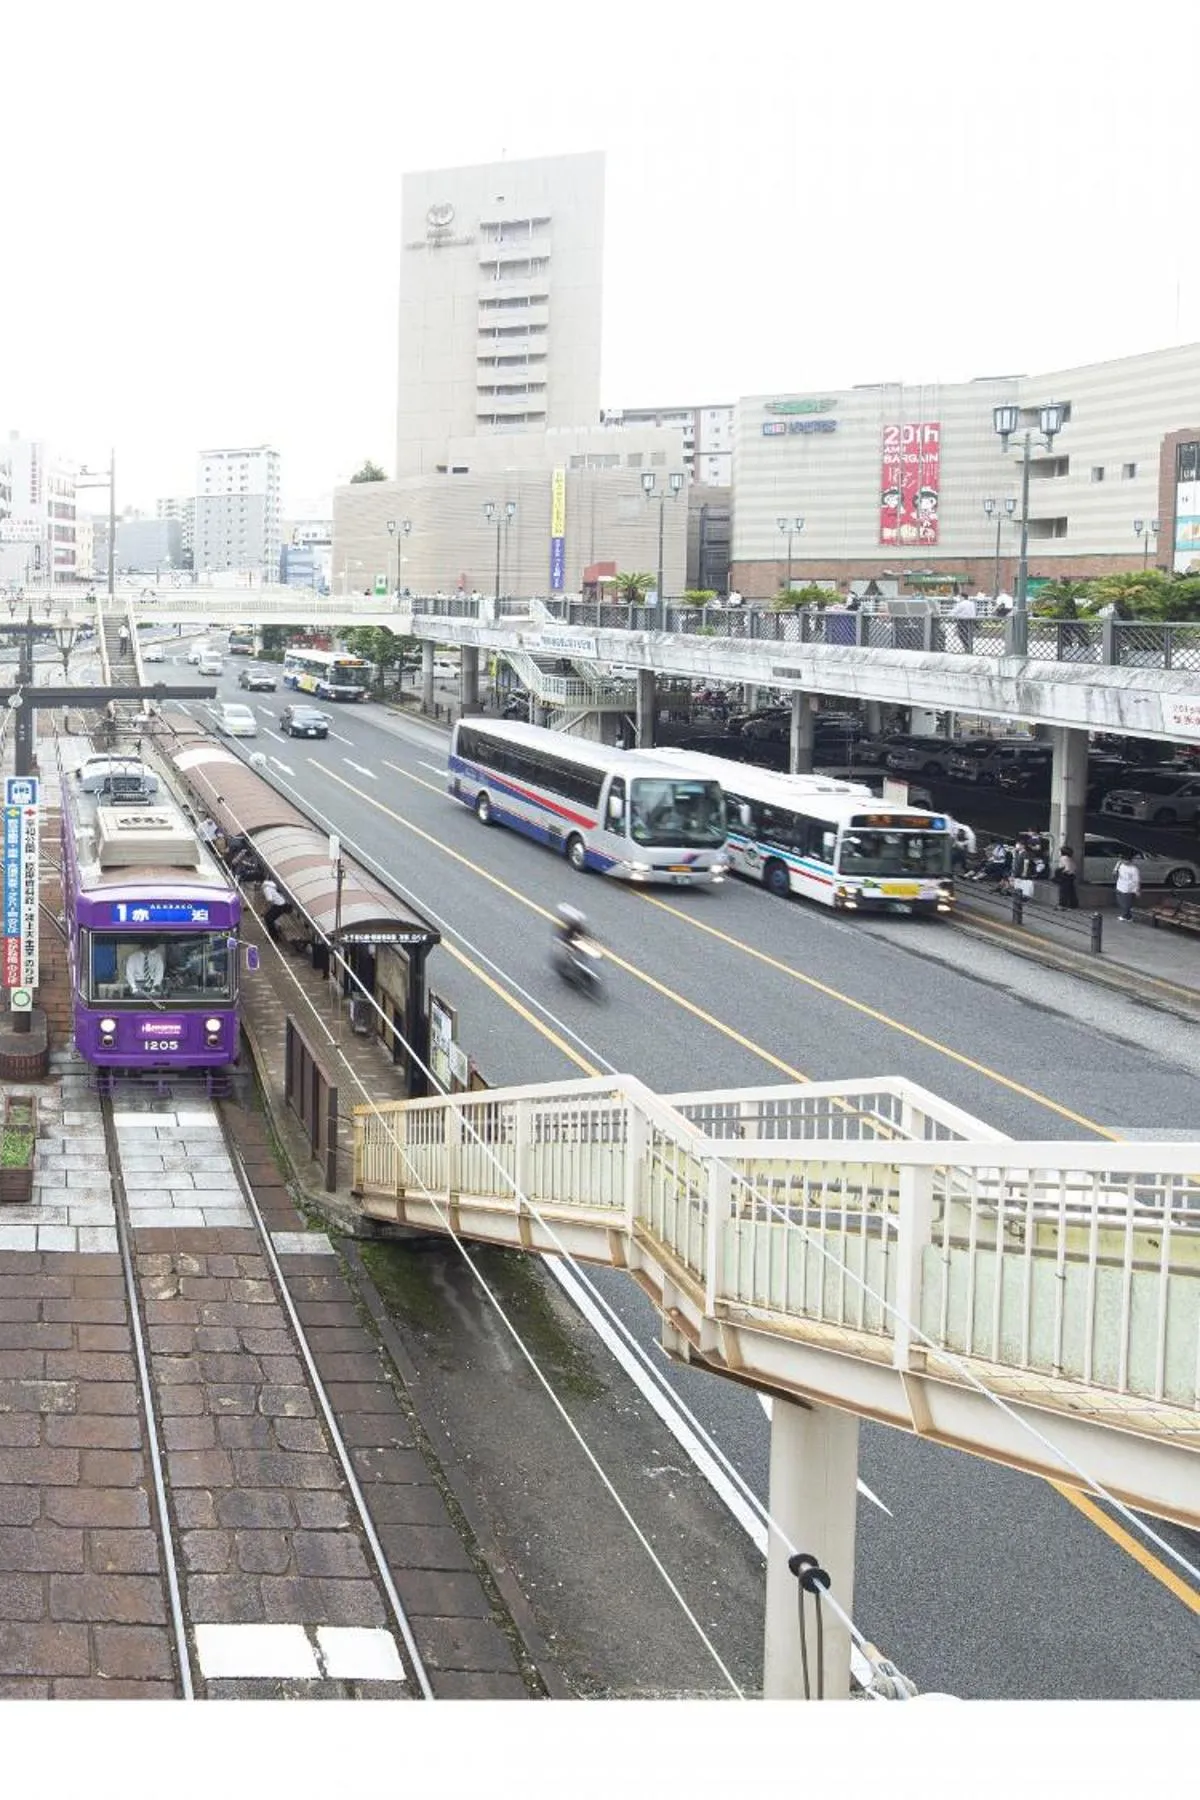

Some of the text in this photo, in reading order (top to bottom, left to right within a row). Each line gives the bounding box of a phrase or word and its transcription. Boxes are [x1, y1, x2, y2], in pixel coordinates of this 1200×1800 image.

[884, 424, 939, 445] 20th
[884, 453, 939, 464] BARGAIN
[117, 903, 128, 922] 1
[144, 1040, 179, 1051] 1205
